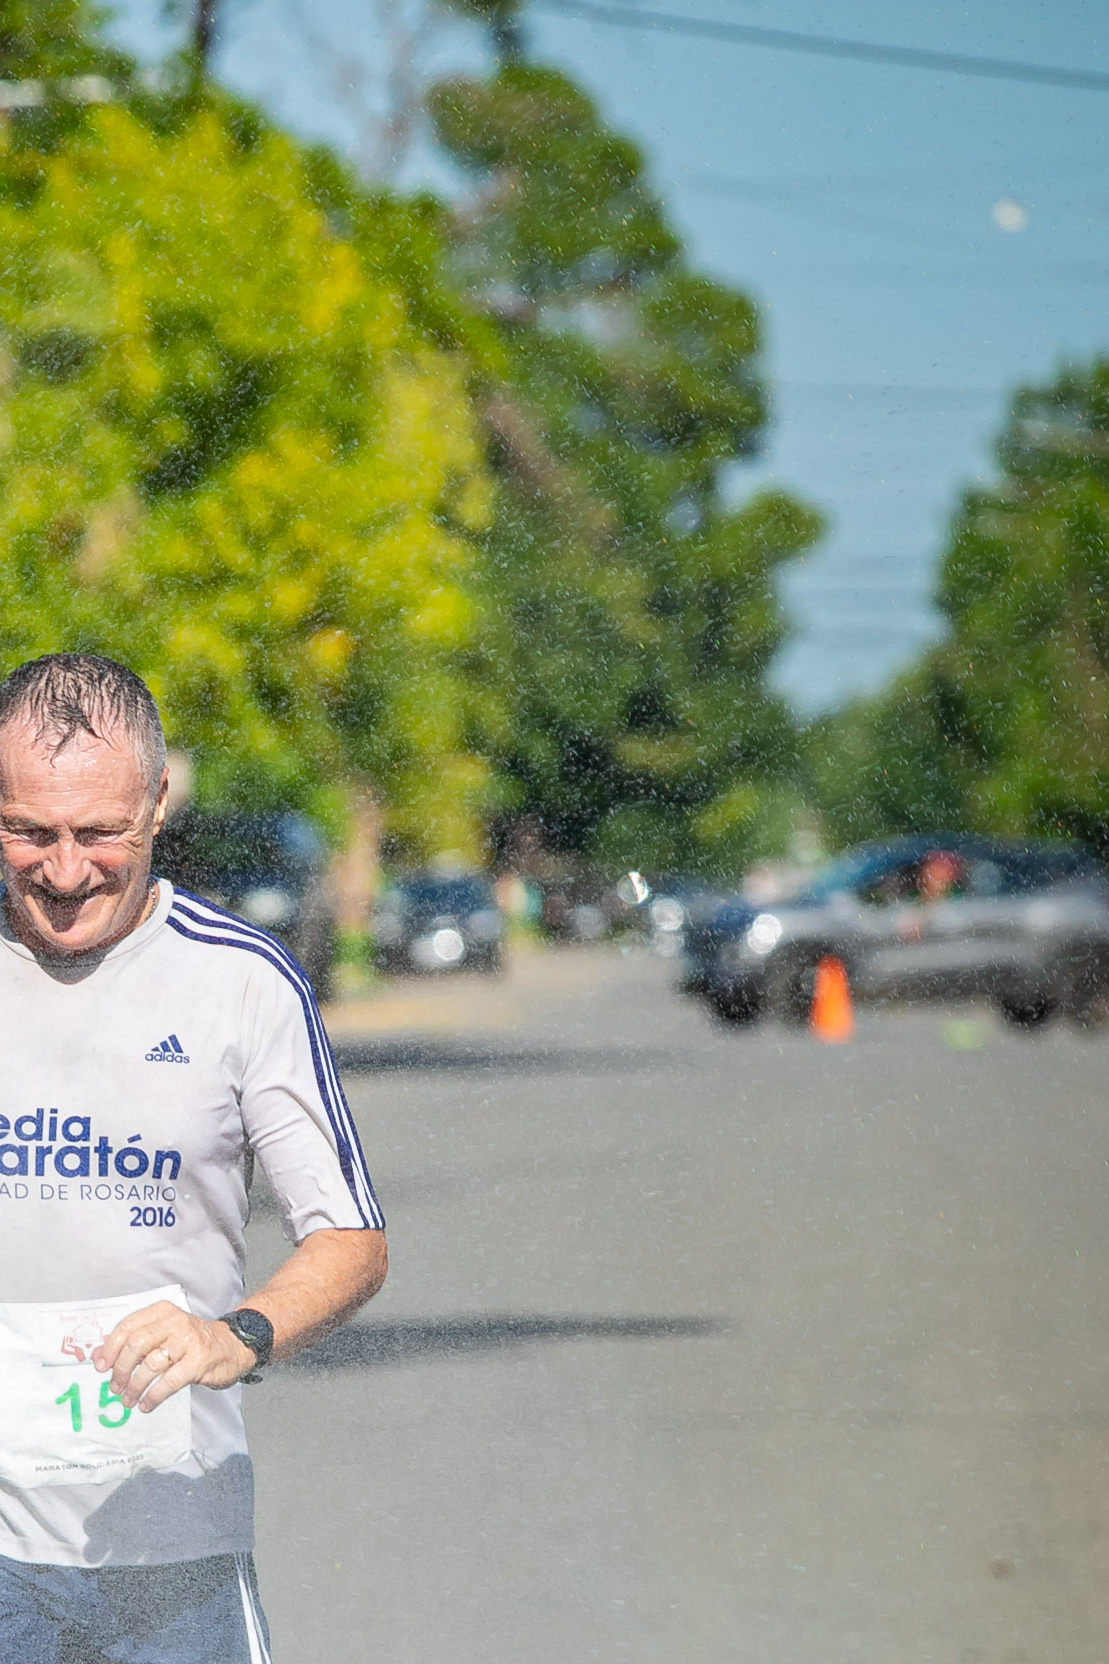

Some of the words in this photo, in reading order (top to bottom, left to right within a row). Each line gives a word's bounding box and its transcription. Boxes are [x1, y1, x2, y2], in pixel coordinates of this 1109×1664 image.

[144, 1051, 190, 1064] adidas
[41, 1183, 69, 1201] DE
[80, 1184, 177, 1202] ROSARIO
[130, 1206, 176, 1227] 2016
[54, 1379, 132, 1433] 15
